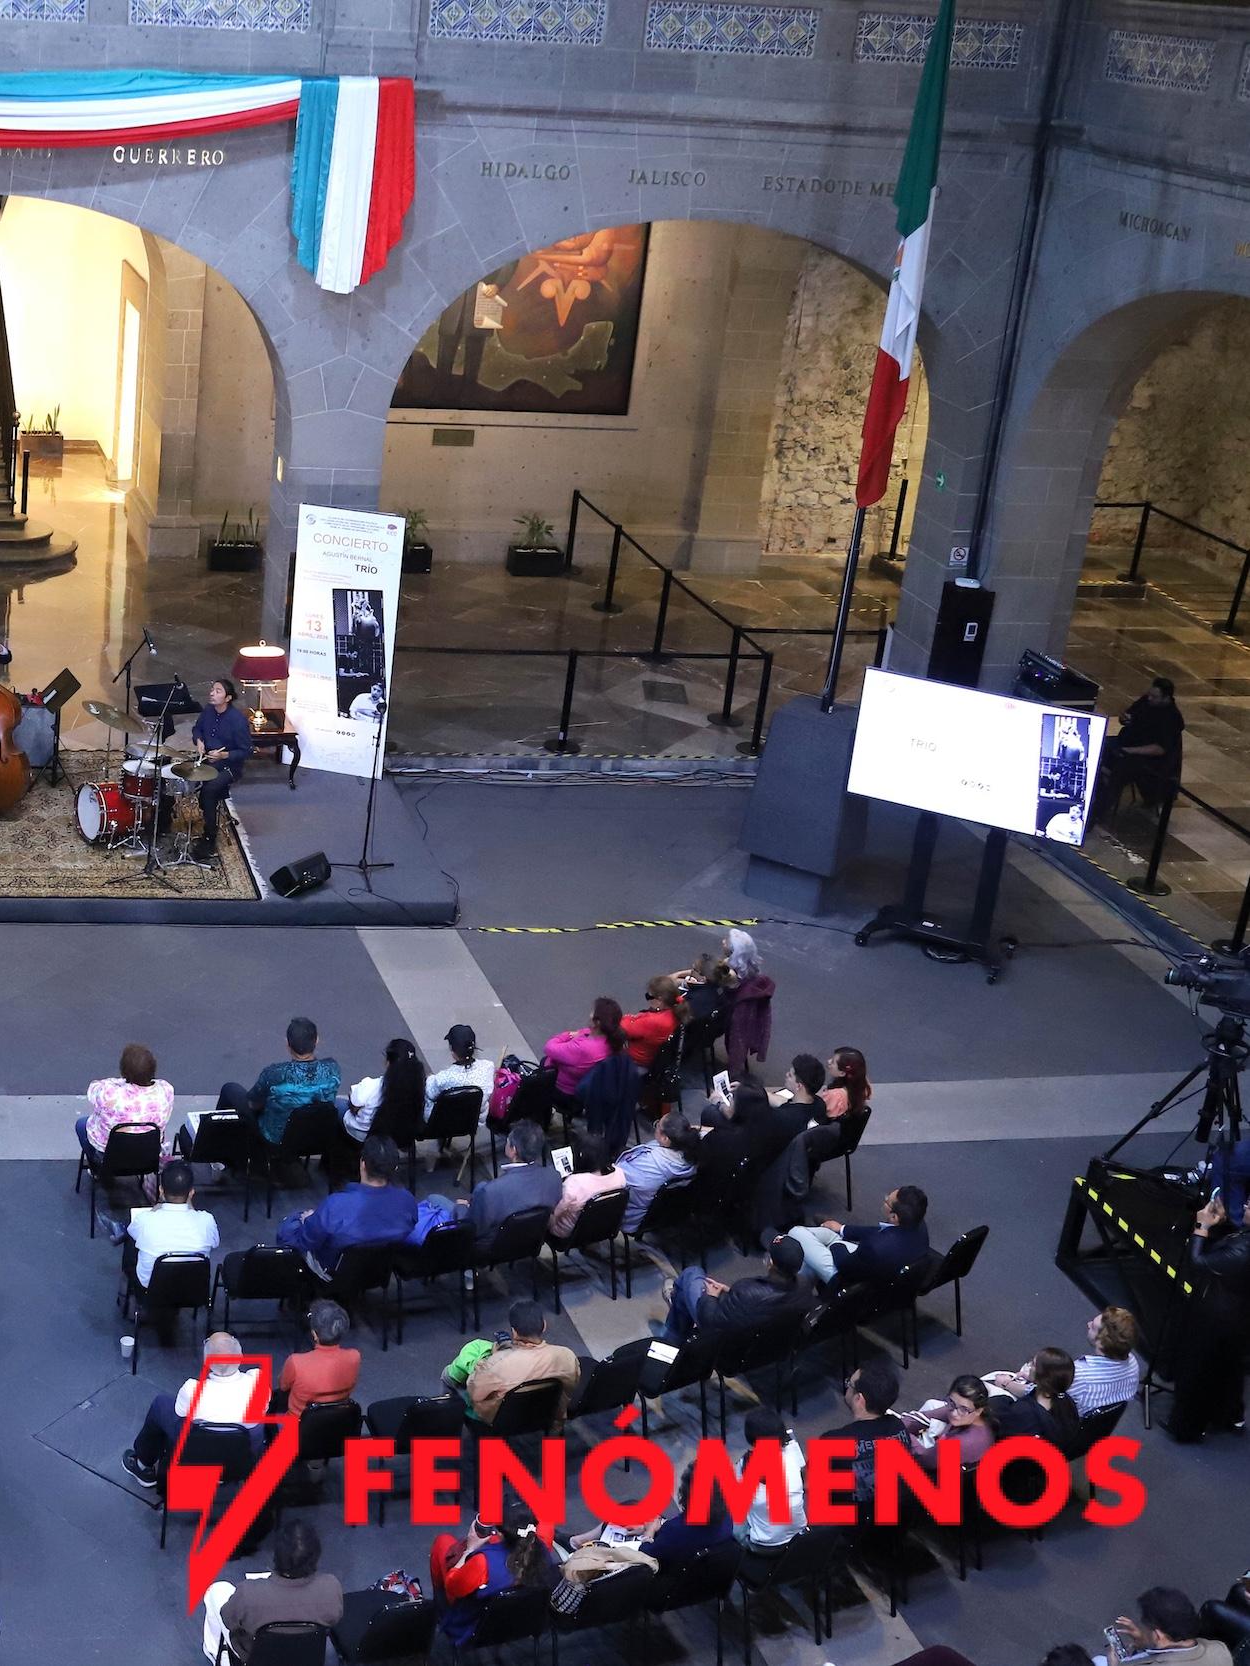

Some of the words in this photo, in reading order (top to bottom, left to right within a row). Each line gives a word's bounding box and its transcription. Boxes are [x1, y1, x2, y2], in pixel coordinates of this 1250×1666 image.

[113, 146, 224, 165] GUERRERO
[481, 162, 571, 180] HIDALGO
[628, 169, 706, 186] JALISCO
[763, 176, 836, 194] ESTADO
[841, 181, 863, 196] DE
[1119, 211, 1191, 242] MICHOACAN
[313, 533, 389, 552] CONCIERTO
[354, 563, 379, 575] TRÍO
[306, 620, 322, 632] 13
